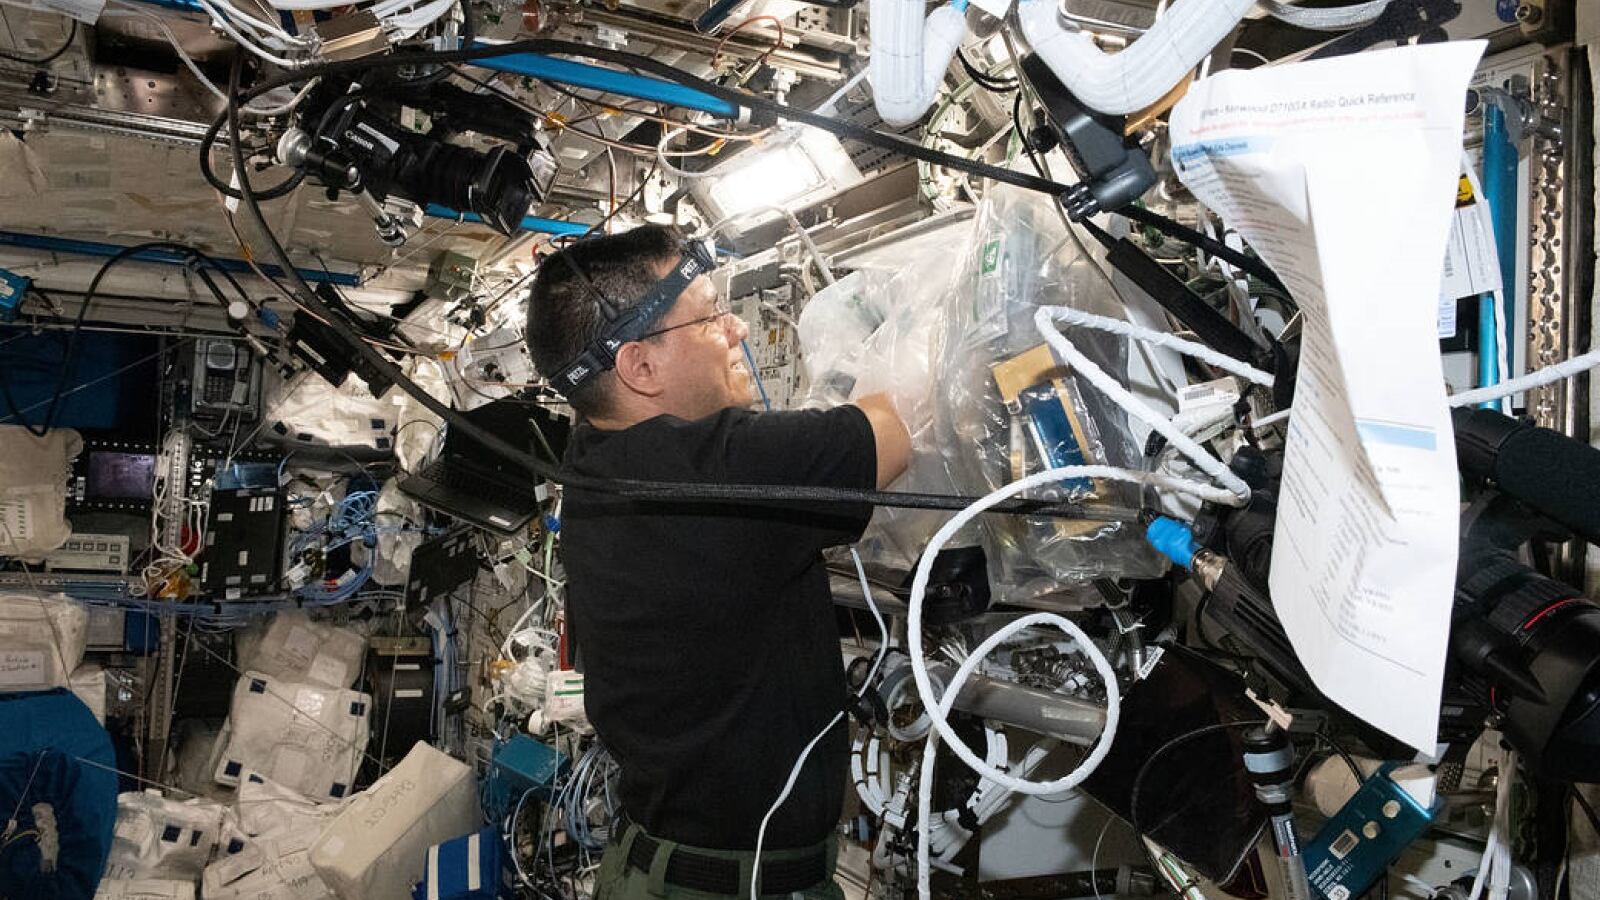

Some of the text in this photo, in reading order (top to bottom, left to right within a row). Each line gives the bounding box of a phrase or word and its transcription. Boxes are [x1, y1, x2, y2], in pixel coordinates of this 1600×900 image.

[1339, 95, 1364, 107] Quick
[1367, 92, 1416, 105] Reference
[345, 130, 374, 150] Canon
